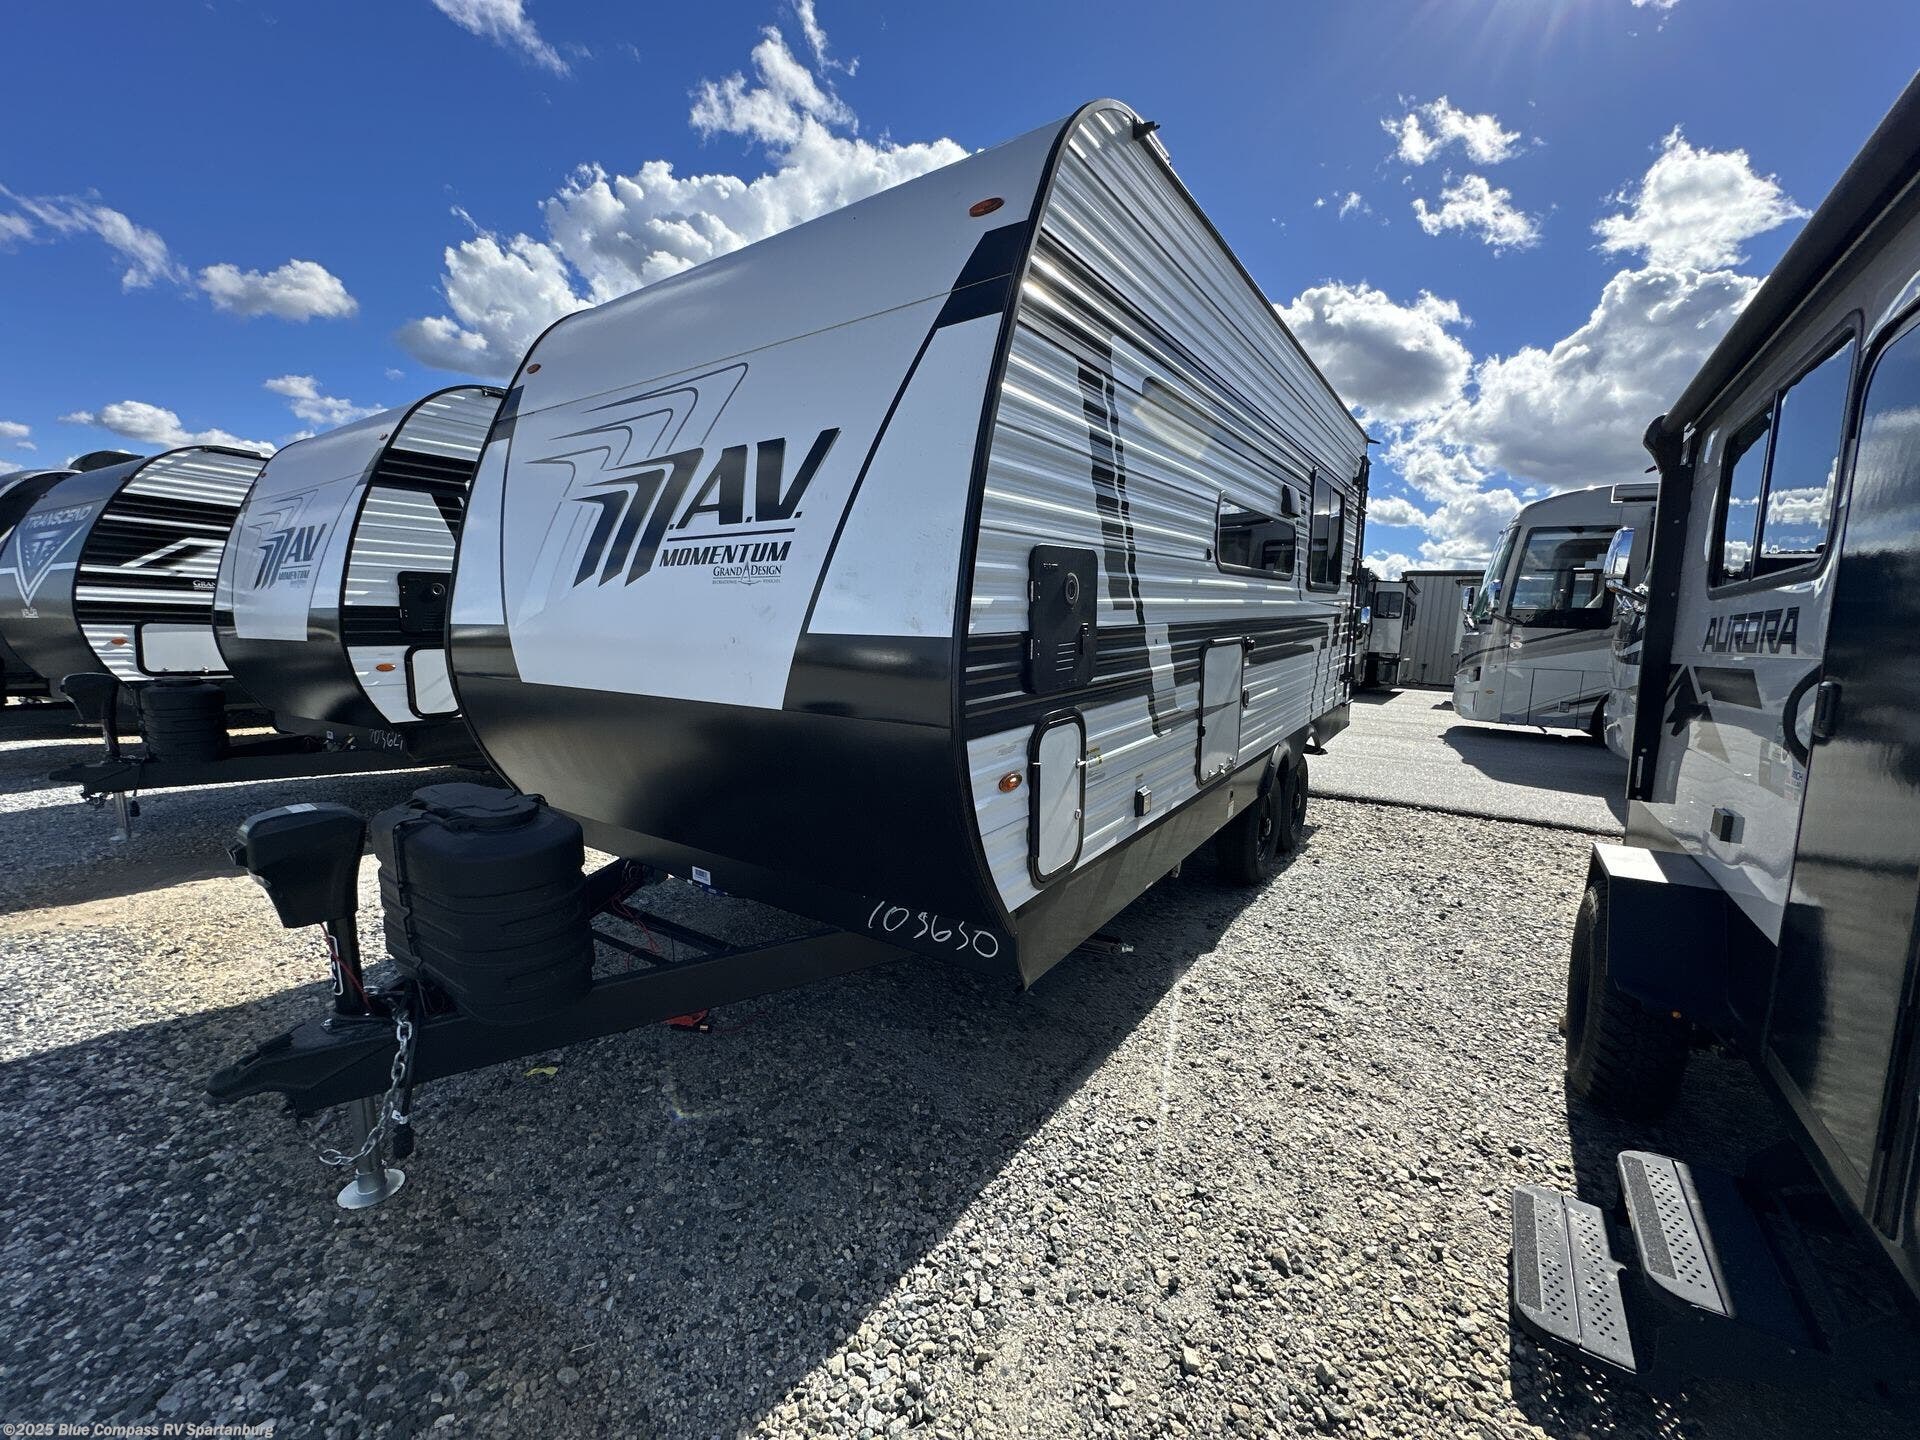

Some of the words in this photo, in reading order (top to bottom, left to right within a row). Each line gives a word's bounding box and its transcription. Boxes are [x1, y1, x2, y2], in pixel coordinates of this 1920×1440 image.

[25, 505, 93, 529] TRANSCEND
[659, 540, 792, 567] MOMENTUM
[713, 565, 743, 576] GRAND
[750, 564, 782, 576] DESIGN
[1702, 606, 1800, 654] AURORA
